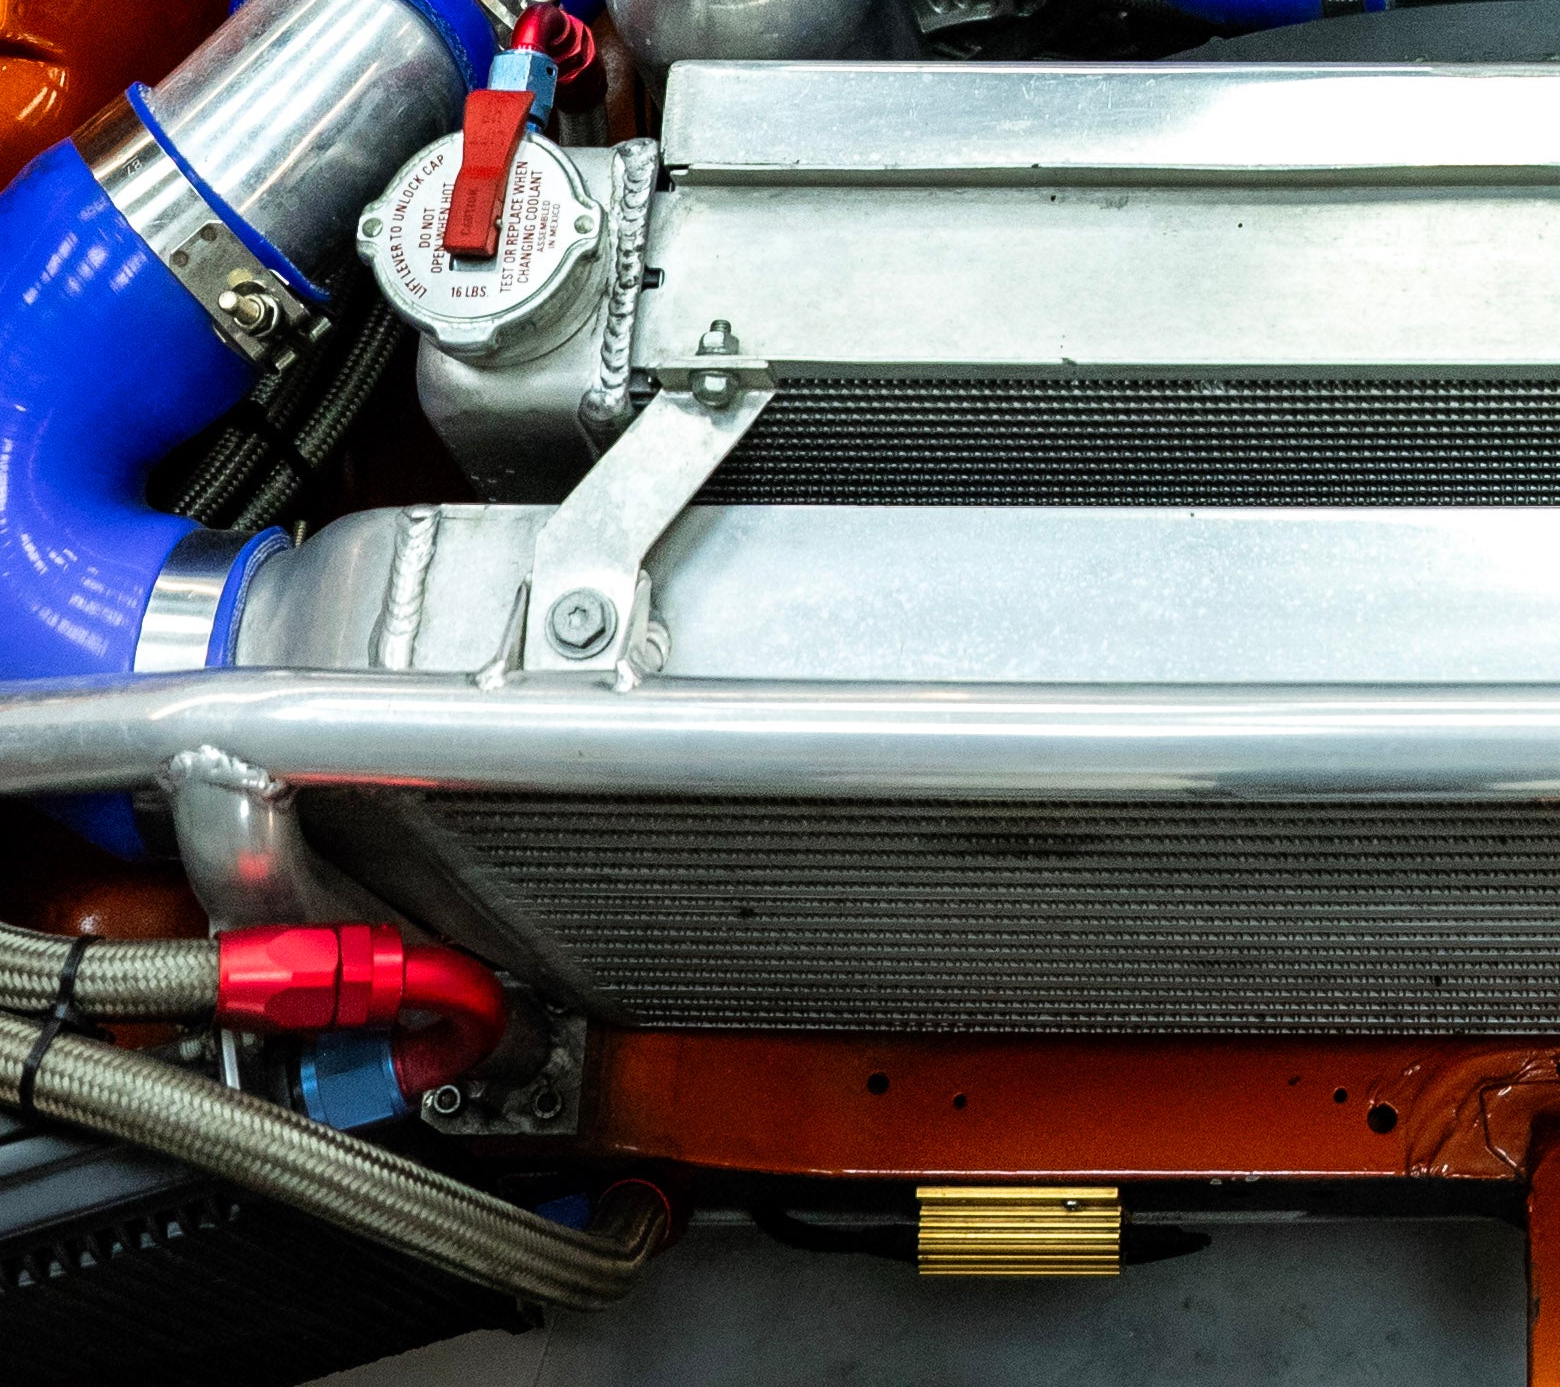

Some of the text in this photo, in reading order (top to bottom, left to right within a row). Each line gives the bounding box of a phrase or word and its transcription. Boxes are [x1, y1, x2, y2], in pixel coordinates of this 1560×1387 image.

[389, 154, 445, 300] LIFT LEVER TO UNLOCK CAP
[418, 206, 436, 249] DO NOT
[499, 160, 529, 294] TEST OR REPLACE WHEN
[516, 169, 543, 284] CHANGING COOLANT
[536, 199, 551, 253] ASSEMBLED
[549, 203, 561, 237] MEXICO
[430, 243, 446, 274] OPEN
[450, 286, 462, 298] 16
